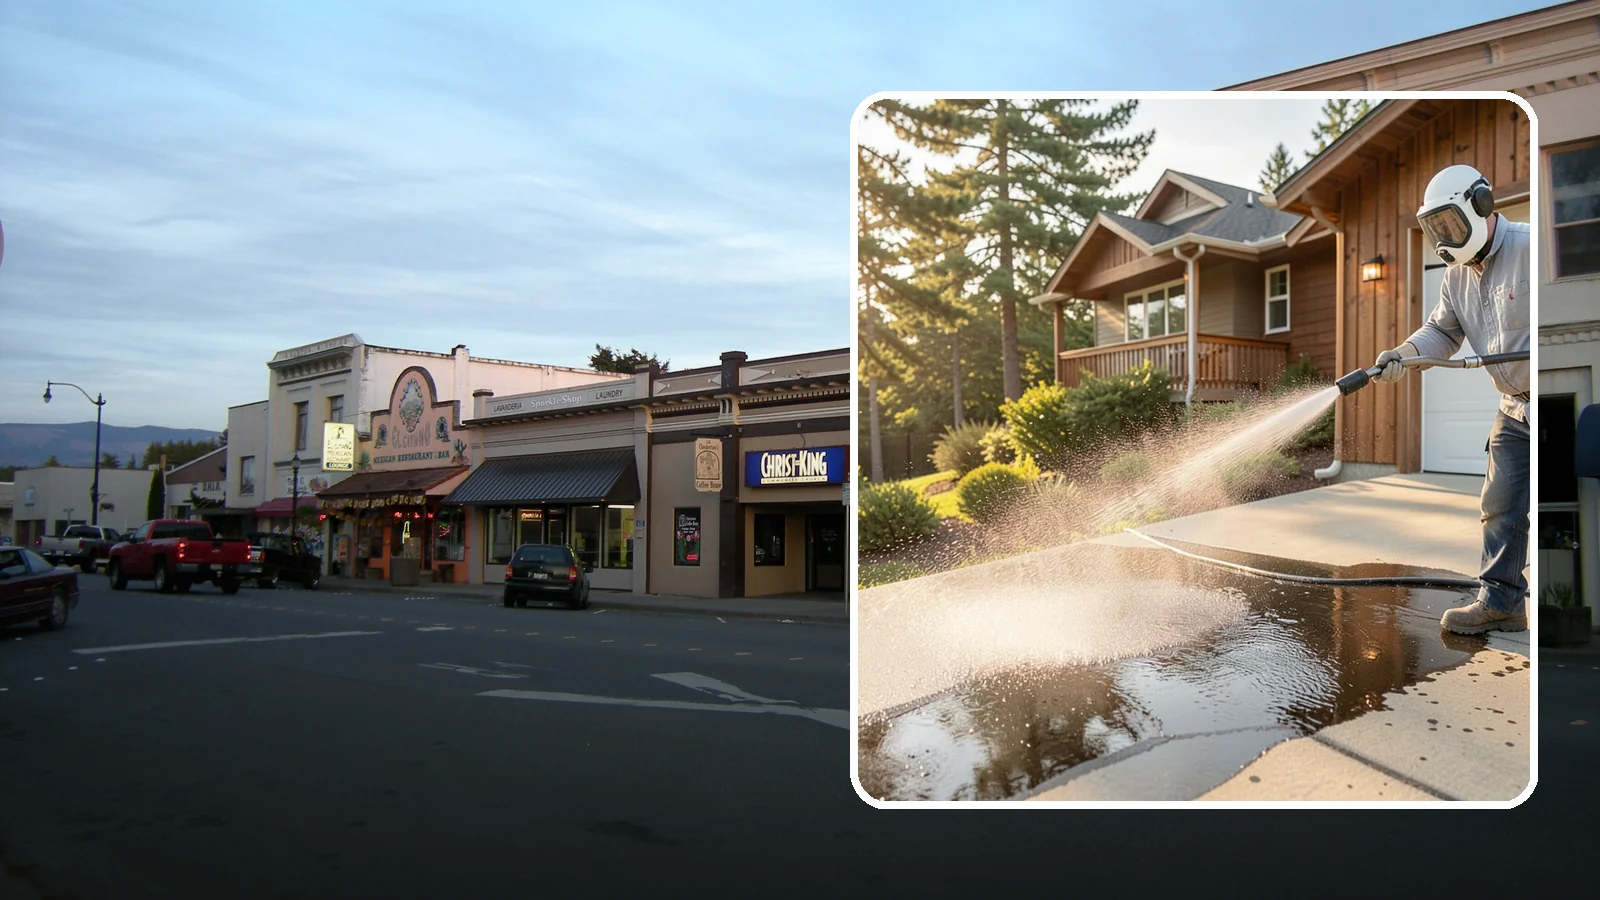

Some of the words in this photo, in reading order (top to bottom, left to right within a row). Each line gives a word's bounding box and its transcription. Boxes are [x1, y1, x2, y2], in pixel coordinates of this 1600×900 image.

[493, 402, 523, 413] LAVANDERIA
[530, 397, 561, 409] Sparkle
[561, 394, 583, 405] Shop
[595, 388, 624, 400] LAUNDRY
[374, 455, 396, 463] MEXICAN
[397, 452, 433, 462] RESTAURANT
[438, 450, 450, 458] BAR
[799, 450, 827, 476] KING
[696, 481, 709, 489] Coffee
